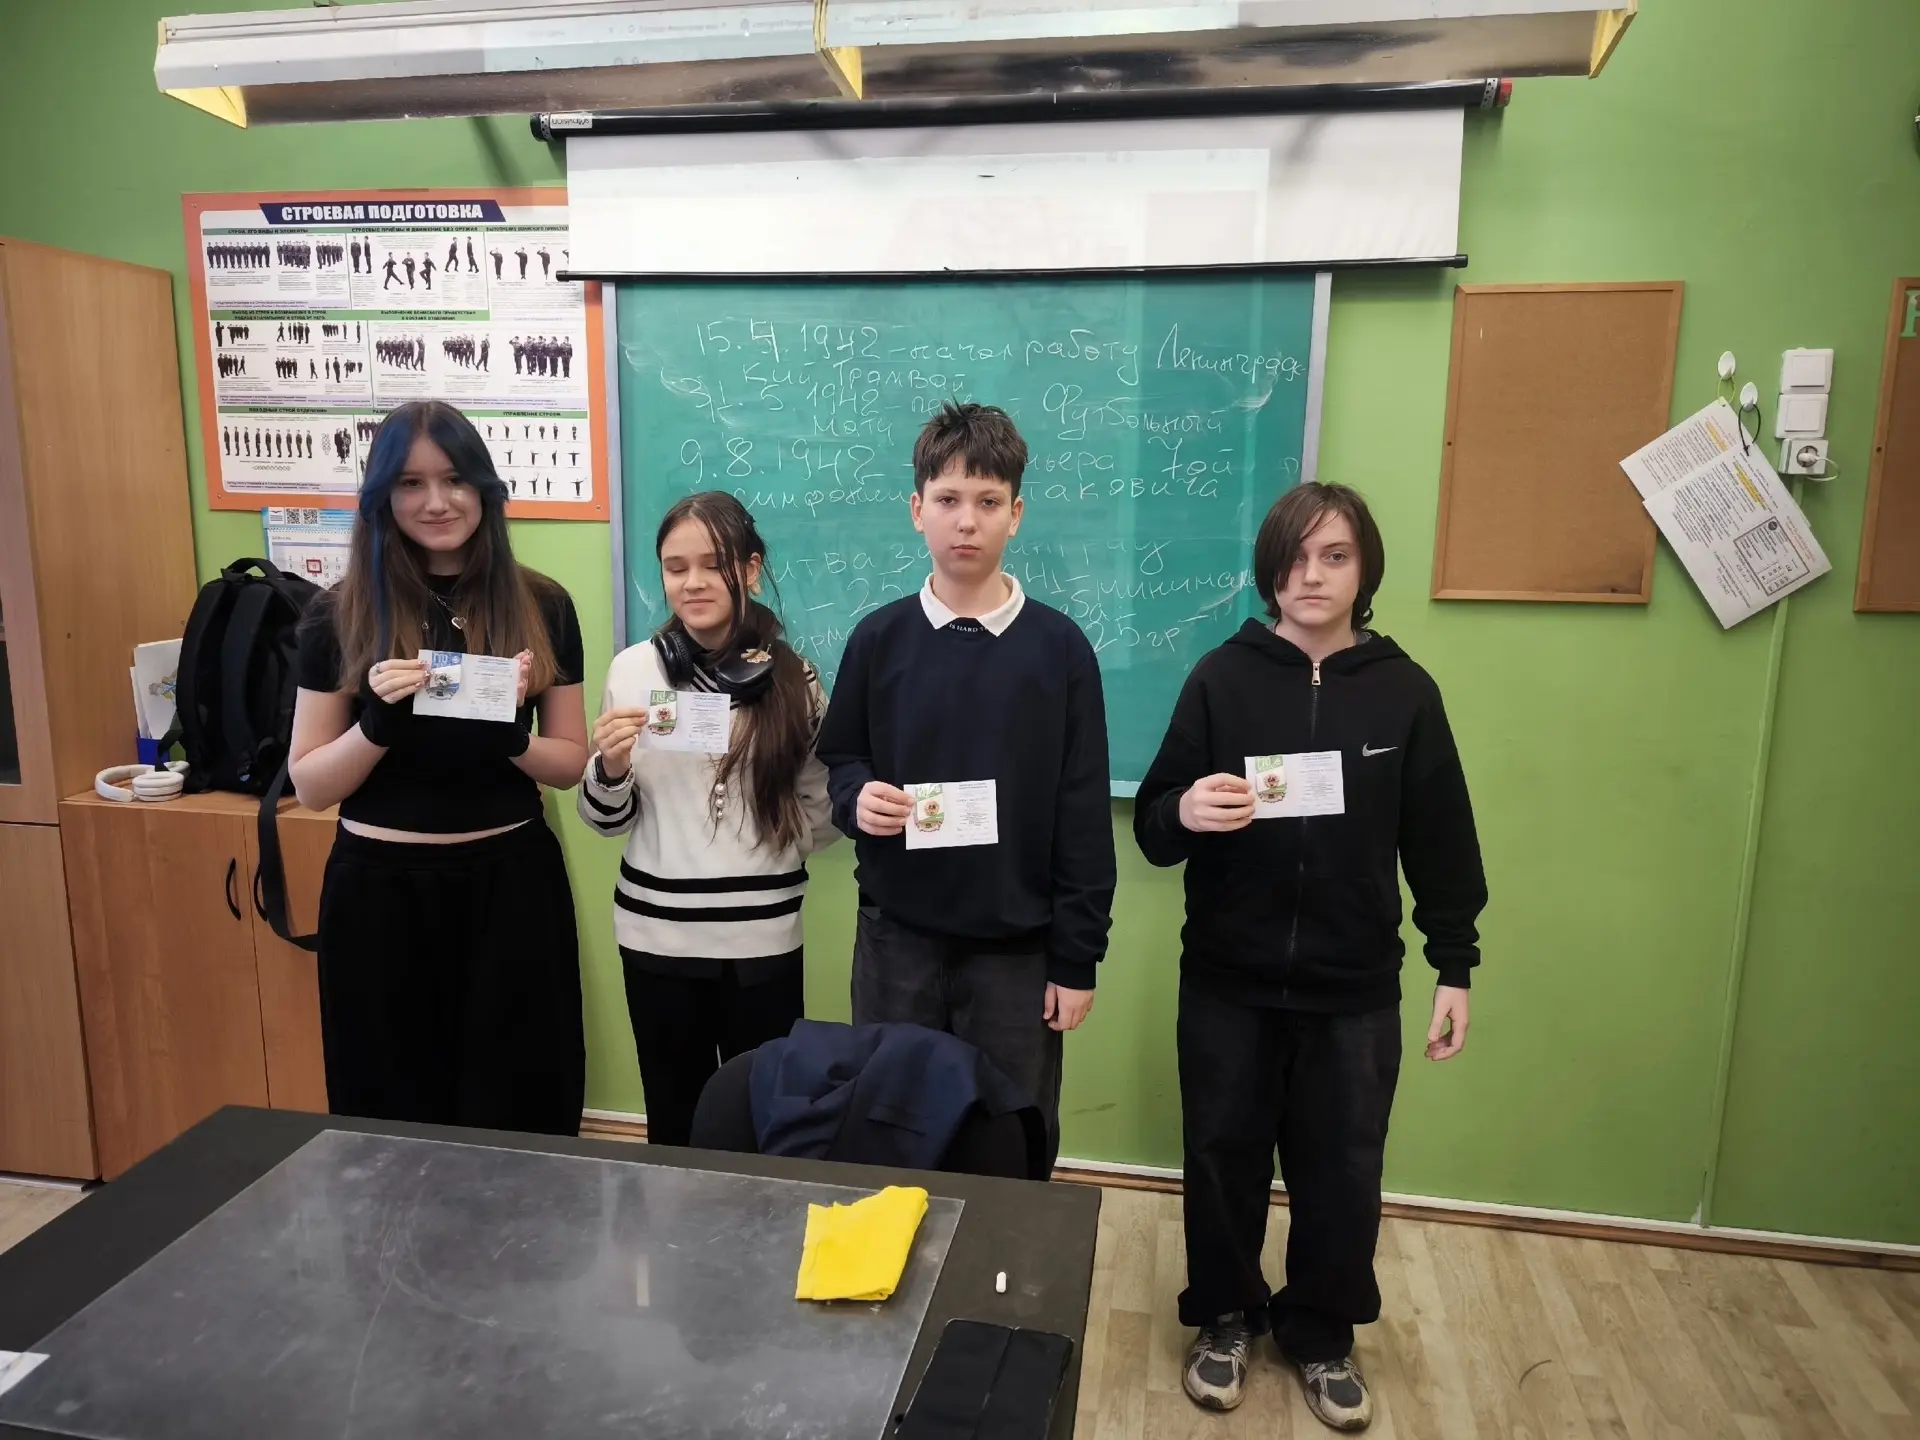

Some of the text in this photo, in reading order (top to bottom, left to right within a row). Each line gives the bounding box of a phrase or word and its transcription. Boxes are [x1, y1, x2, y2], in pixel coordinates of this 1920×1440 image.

[281, 204, 484, 222] СТРОЕВАЯ ПОДГОТОВКА
[1026, 329, 1138, 386] работу
[956, 625, 978, 633] HARD
